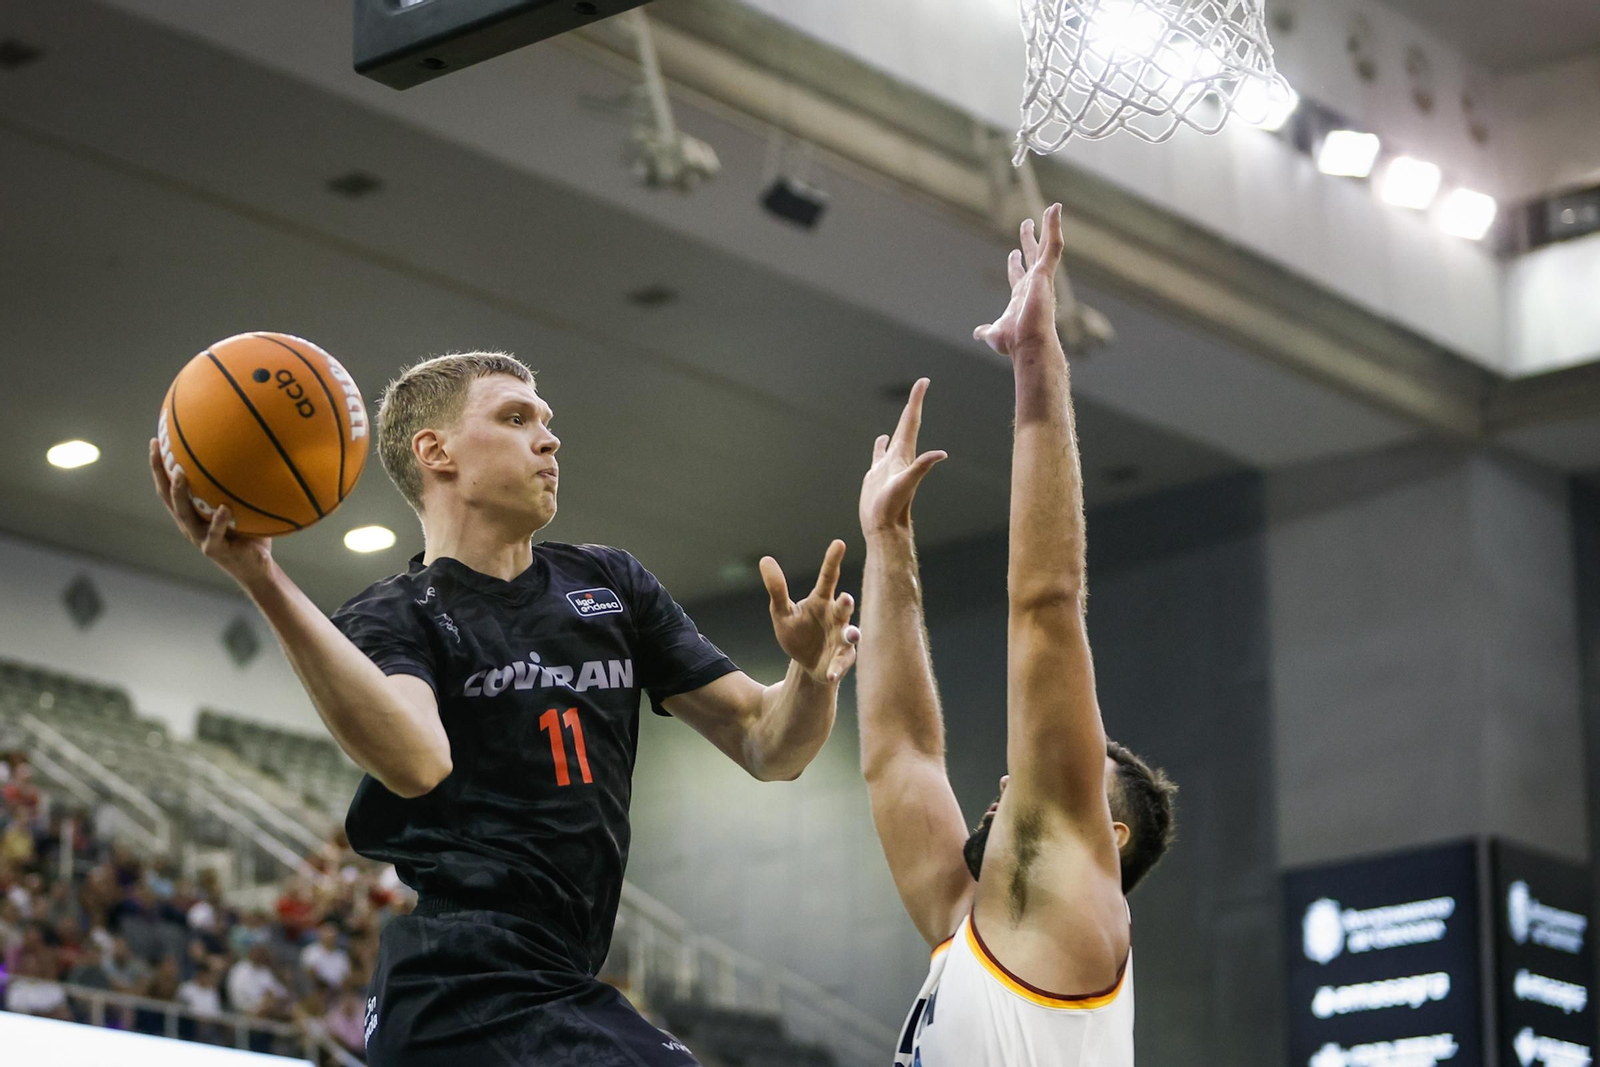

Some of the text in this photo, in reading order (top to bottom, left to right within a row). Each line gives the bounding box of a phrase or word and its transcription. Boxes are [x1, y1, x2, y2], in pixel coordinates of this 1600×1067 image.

[274, 369, 315, 419] acb
[575, 598, 595, 607] liga
[581, 601, 619, 613] endesa
[539, 707, 593, 786] 11
